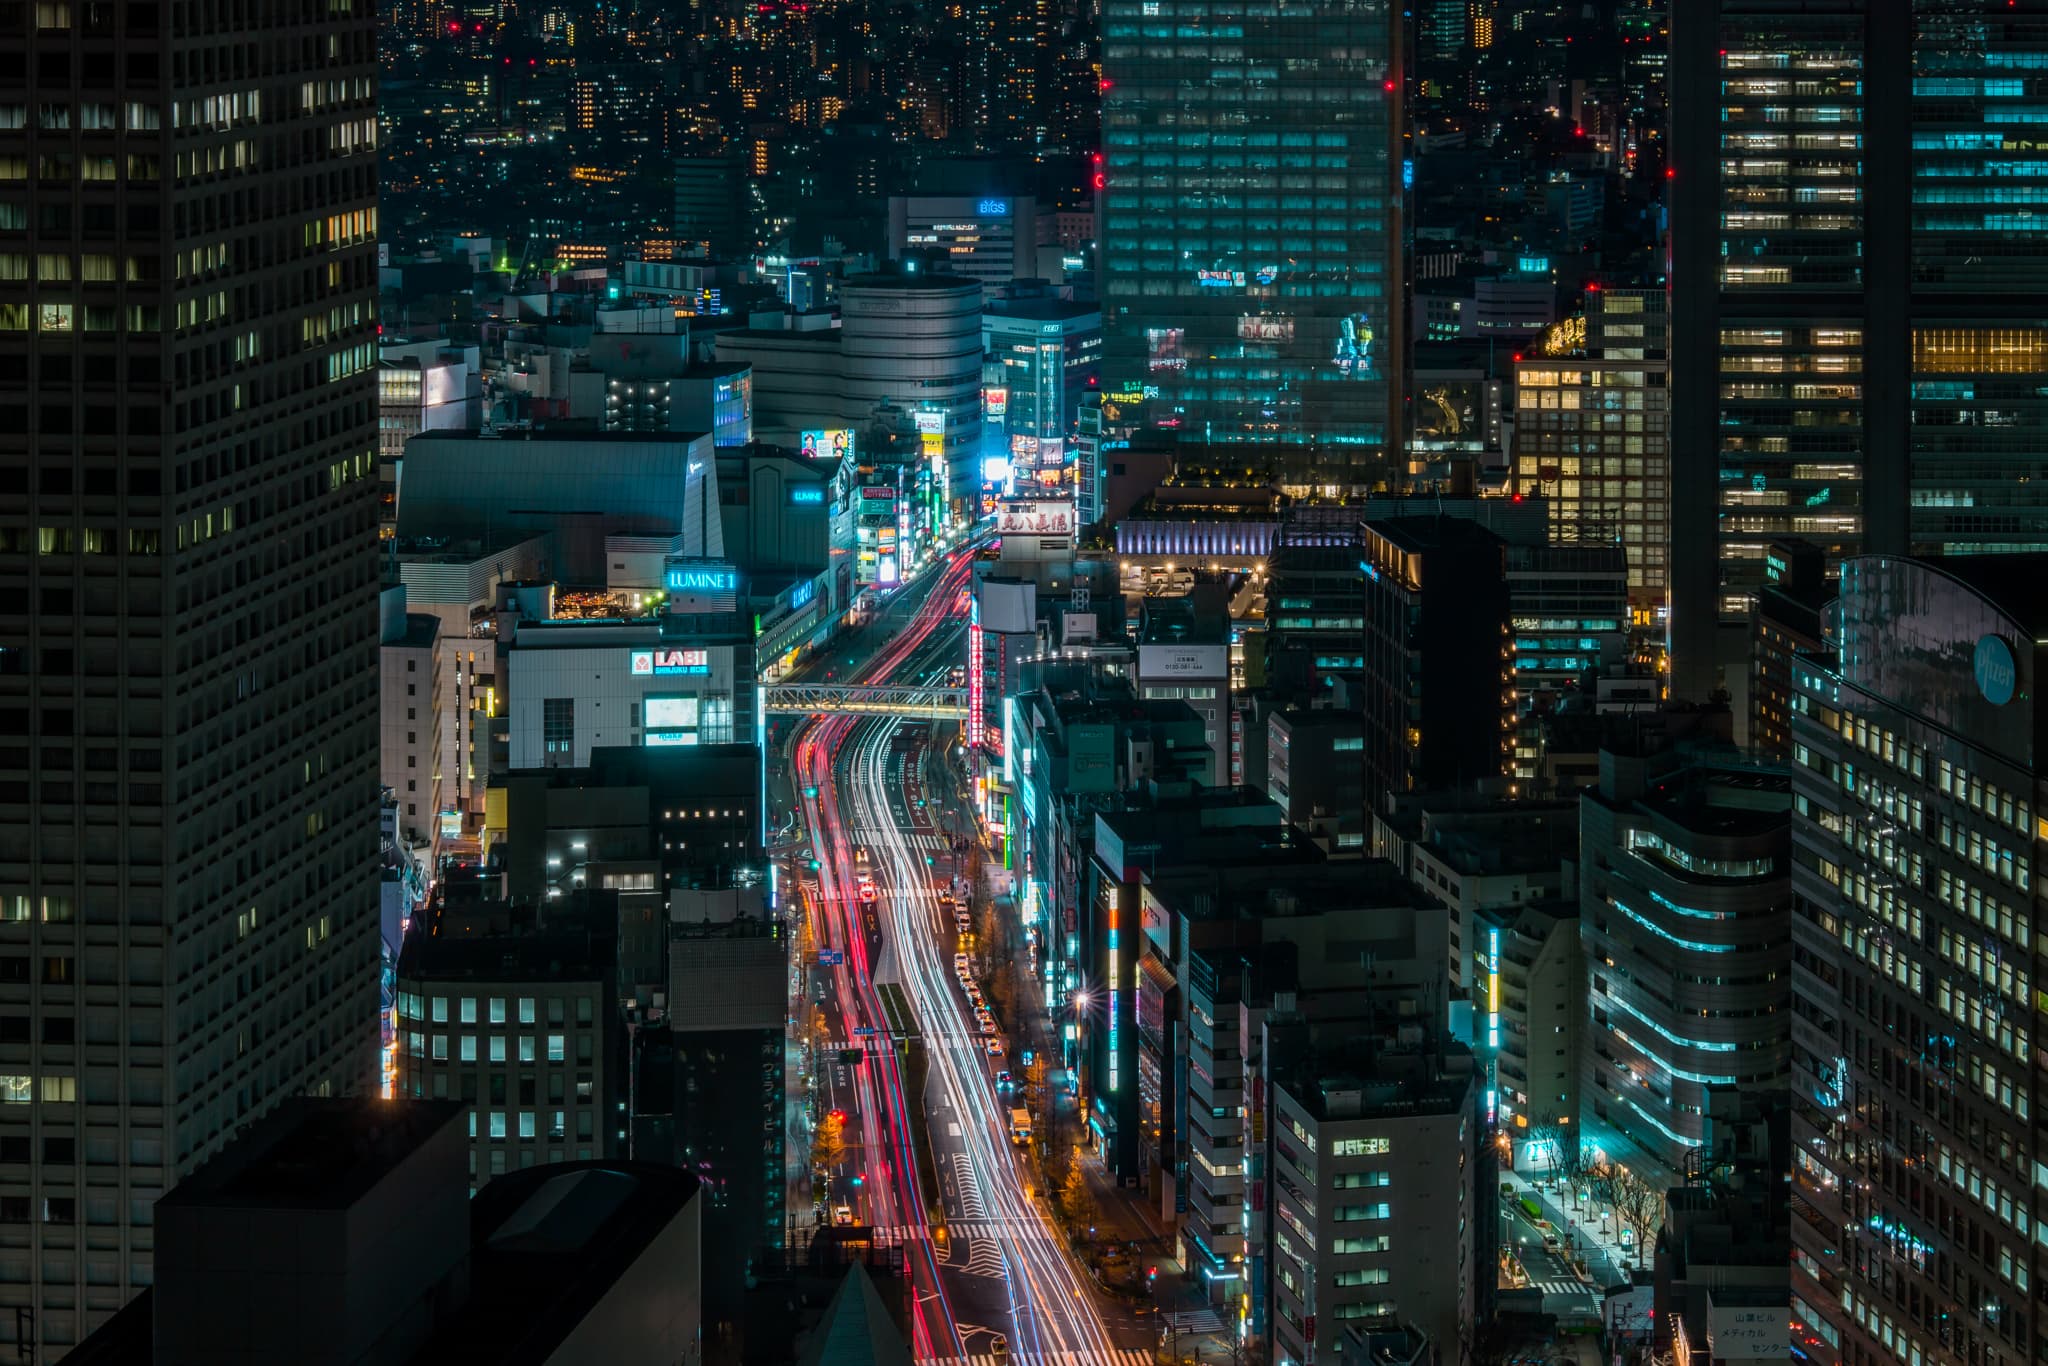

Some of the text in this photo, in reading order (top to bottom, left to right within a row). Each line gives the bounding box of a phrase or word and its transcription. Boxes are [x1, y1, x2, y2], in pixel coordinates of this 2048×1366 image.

[671, 573, 725, 588] LUMINE
[655, 650, 707, 667] LABI
[655, 666, 688, 674] SHINJUKU
[1976, 643, 2014, 695] Pfizer
[1721, 1328, 1766, 1338] メディカル
[1752, 1344, 1789, 1353] センター
